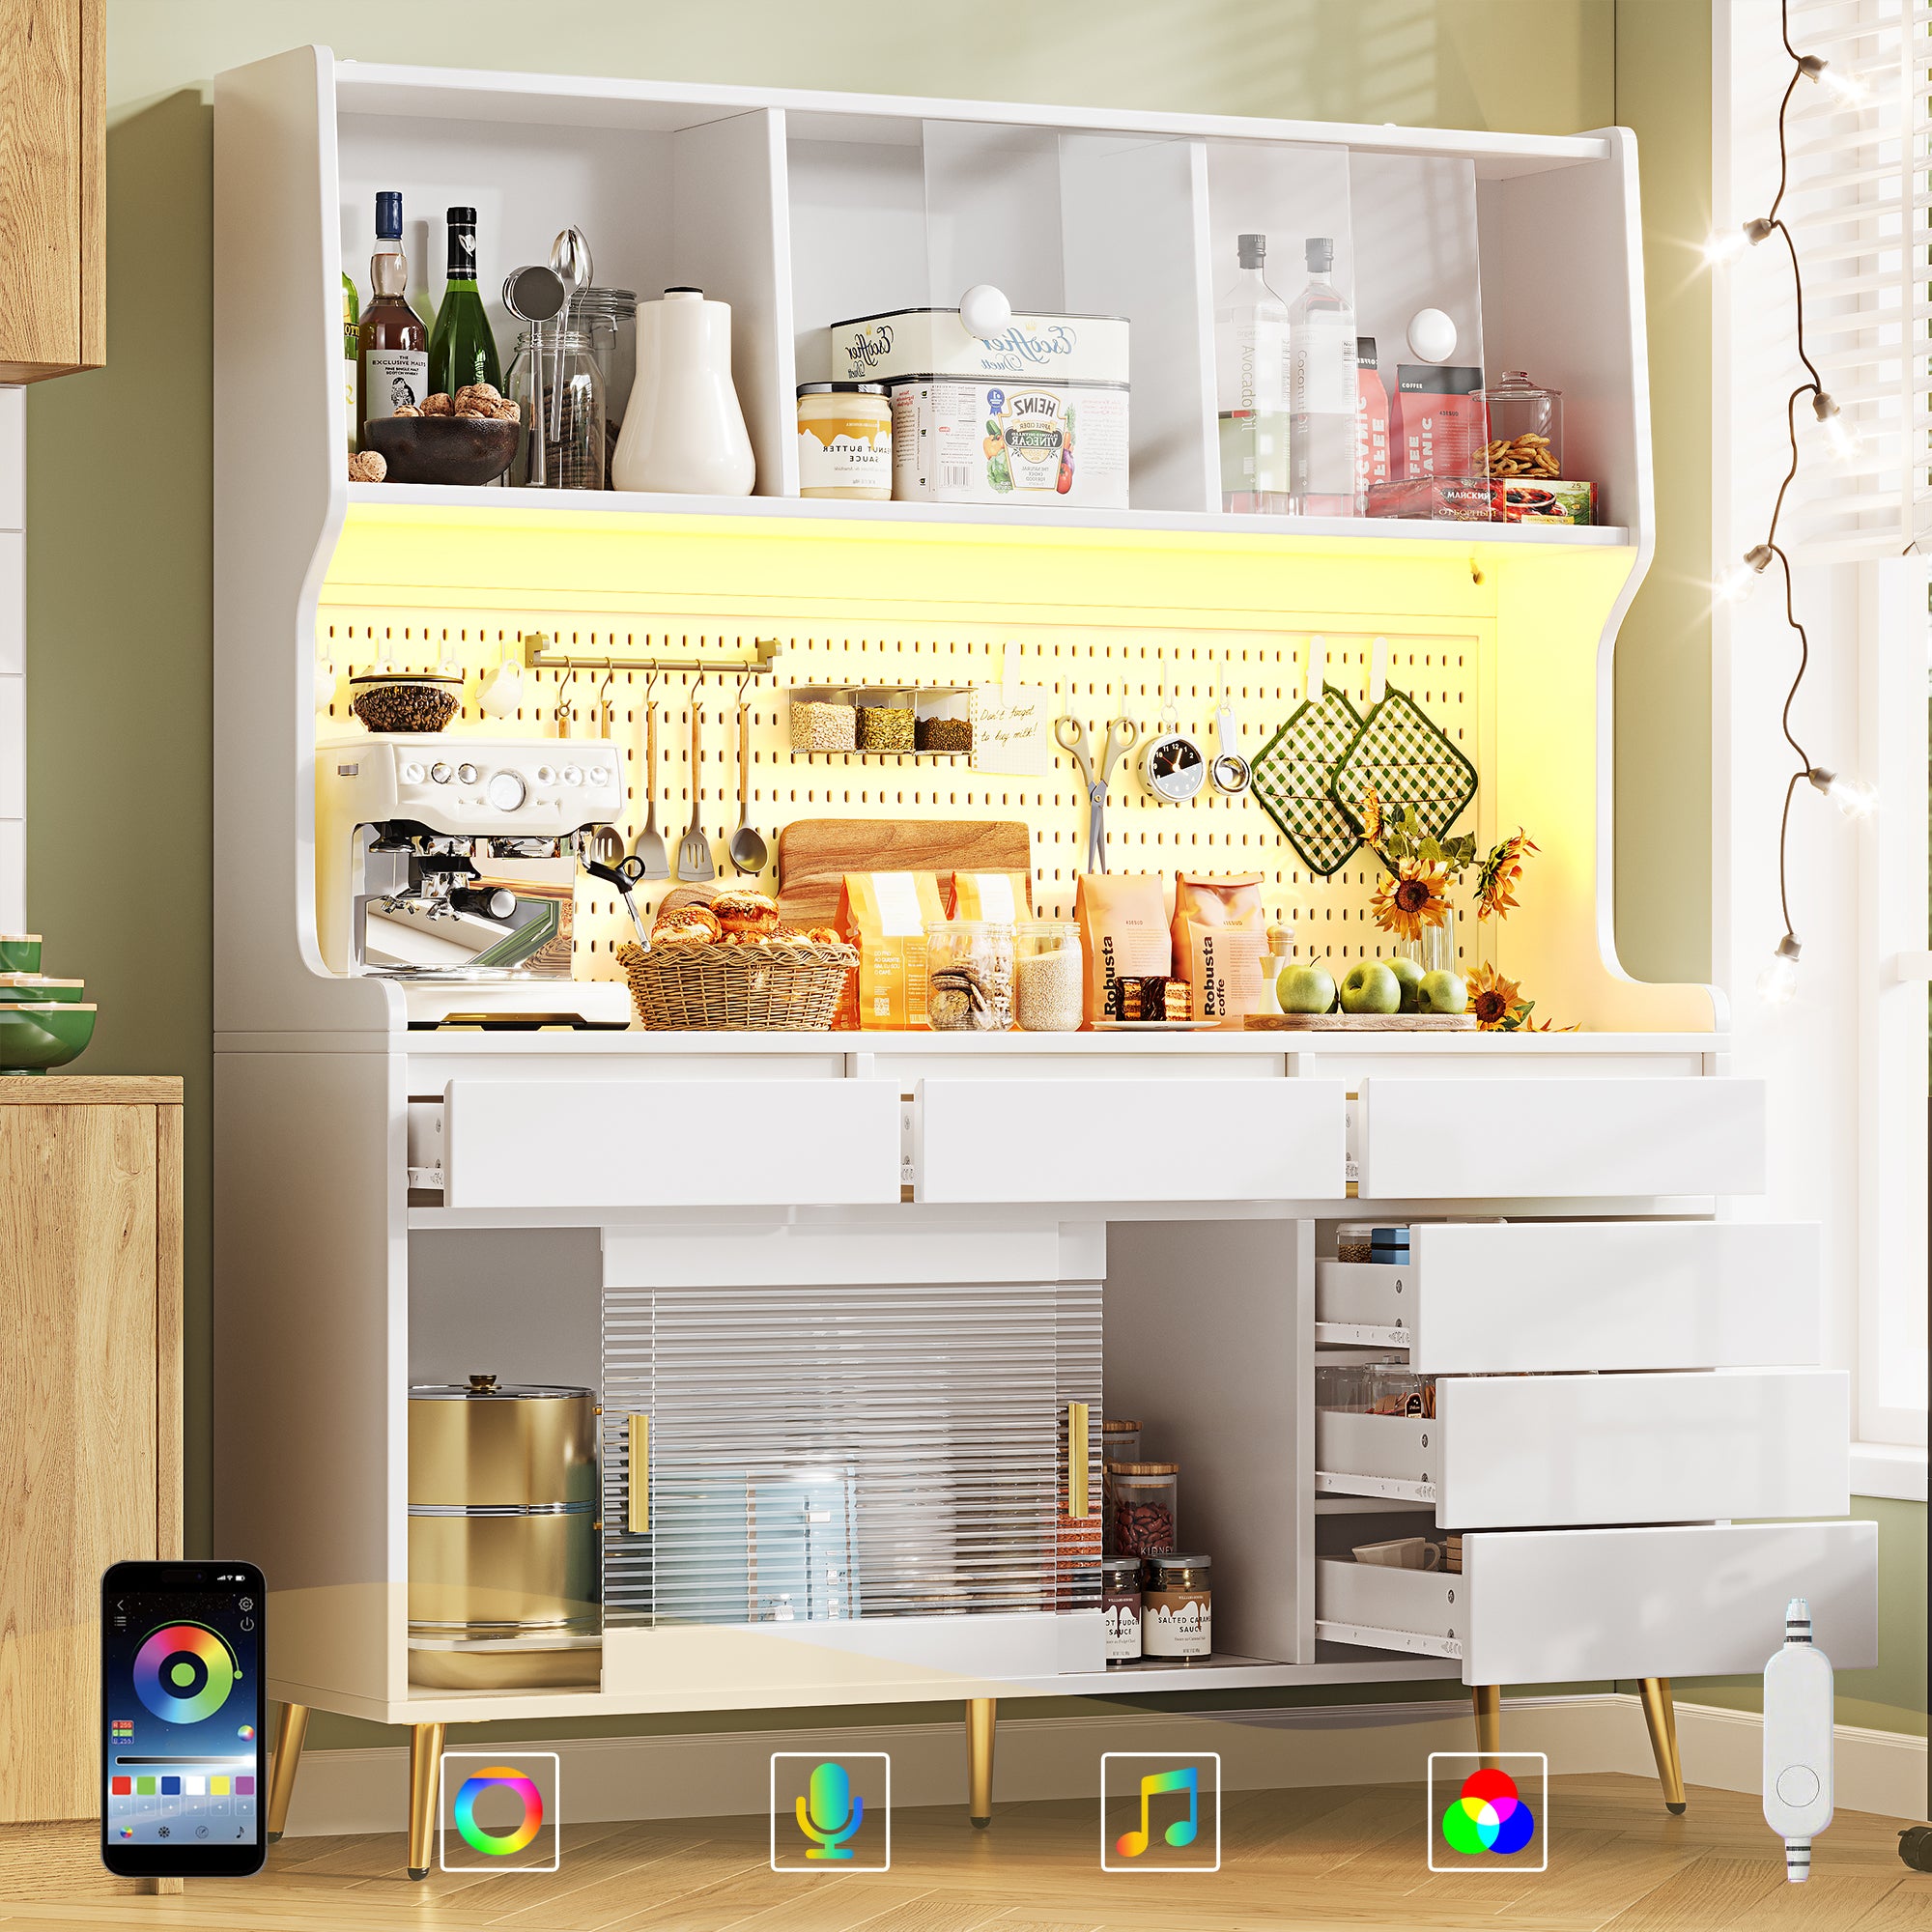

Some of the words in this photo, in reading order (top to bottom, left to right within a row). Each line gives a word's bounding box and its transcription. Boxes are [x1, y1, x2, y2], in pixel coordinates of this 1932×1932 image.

[1241, 345, 1256, 408] Avocado
[1297, 350, 1307, 411] Coconut
[1422, 417, 1434, 478] ANIC
[980, 708, 1005, 721] Don't
[1009, 704, 1035, 721] forget
[981, 730, 990, 742] to
[995, 729, 1009, 748] buy
[1101, 936, 1117, 1016] Robusta
[1203, 936, 1216, 1016] Robusta
[1216, 979, 1226, 1016] coffe
[1140, 1547, 1174, 1555] KIDNEY
